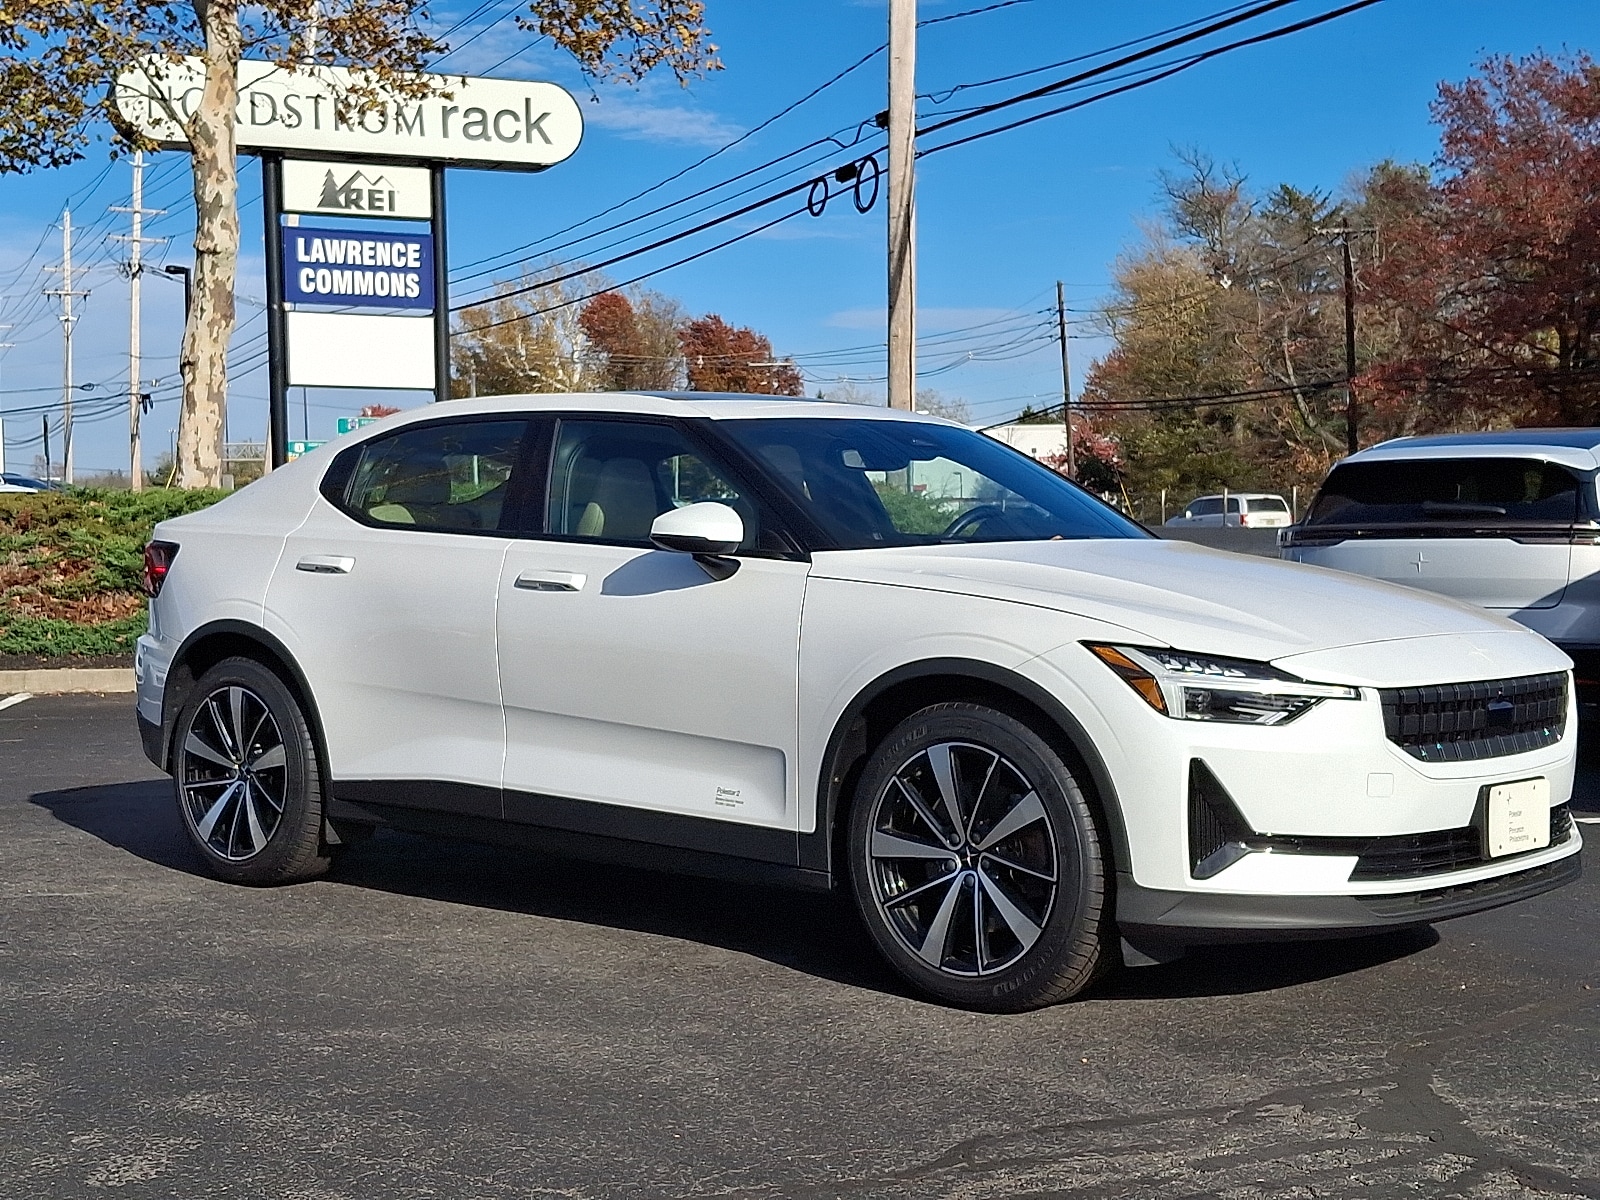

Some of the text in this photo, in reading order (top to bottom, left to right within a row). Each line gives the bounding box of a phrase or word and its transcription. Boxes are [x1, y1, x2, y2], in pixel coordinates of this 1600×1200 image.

[441, 97, 554, 146] rack
[345, 187, 396, 212] REI
[297, 237, 421, 269] LAWRENCE
[299, 267, 421, 298] COMMONS
